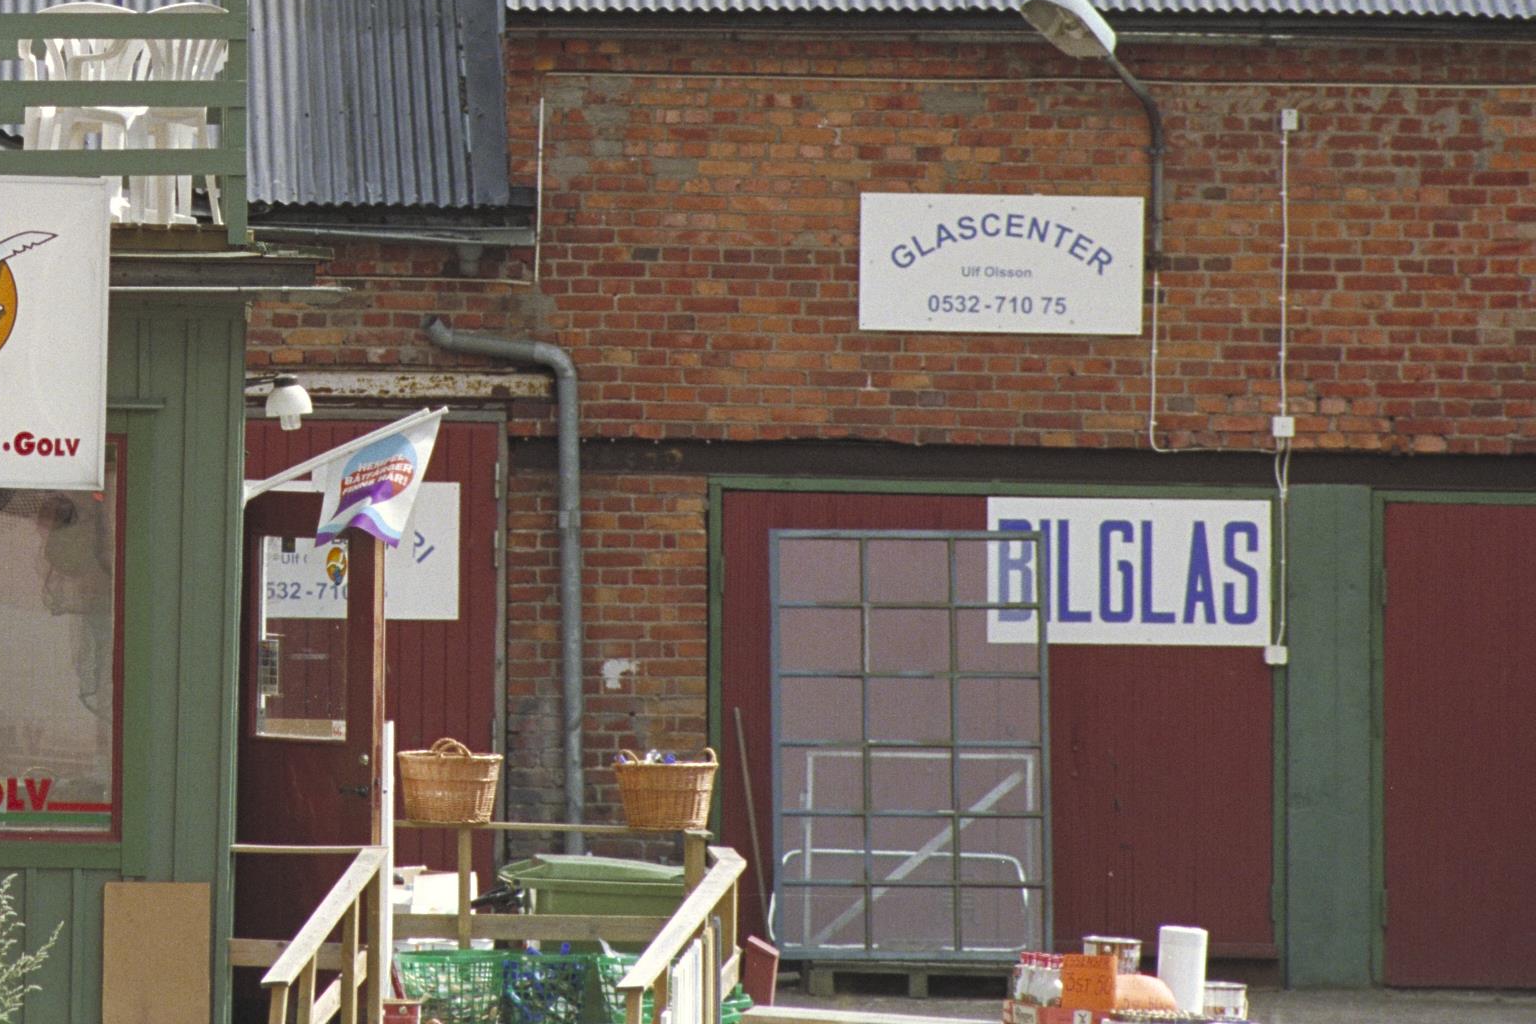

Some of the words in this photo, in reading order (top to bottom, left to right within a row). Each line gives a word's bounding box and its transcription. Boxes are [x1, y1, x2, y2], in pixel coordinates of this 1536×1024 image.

[890, 212, 1114, 276] GLASCENTER
[961, 266, 981, 278] Ulf
[984, 266, 1033, 278] Olsson
[1041, 296, 1067, 315] 75
[997, 518, 1259, 625] BILGLAS
